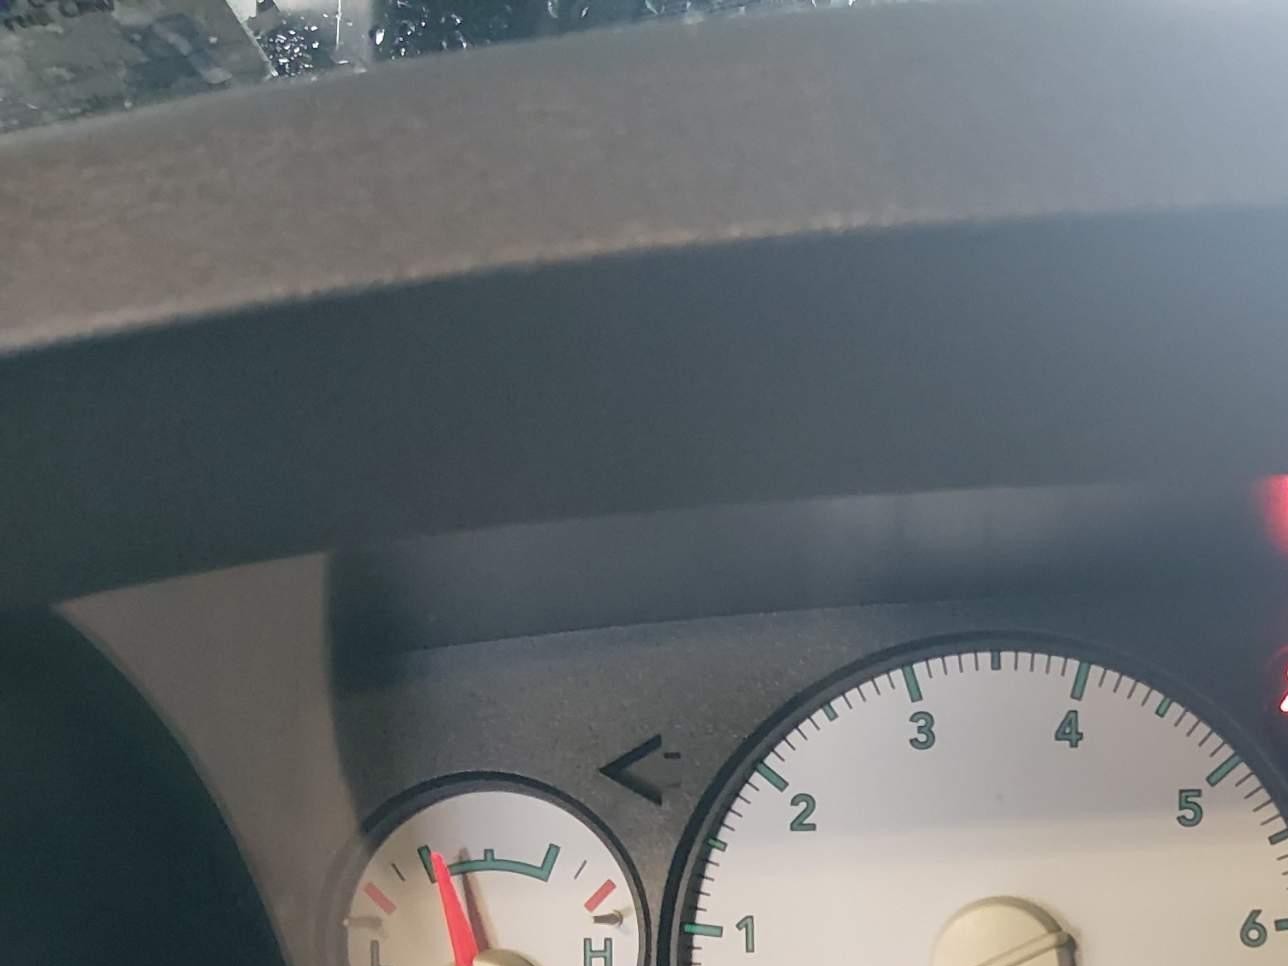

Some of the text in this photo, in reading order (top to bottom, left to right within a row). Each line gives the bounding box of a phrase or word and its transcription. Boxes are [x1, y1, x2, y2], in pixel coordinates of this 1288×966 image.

[909, 712, 935, 749] 3
[1055, 711, 1083, 747] 4
[790, 793, 816, 831] 2
[1177, 789, 1202, 827] 5
[735, 916, 755, 952] 1
[1240, 910, 1267, 948] 6
